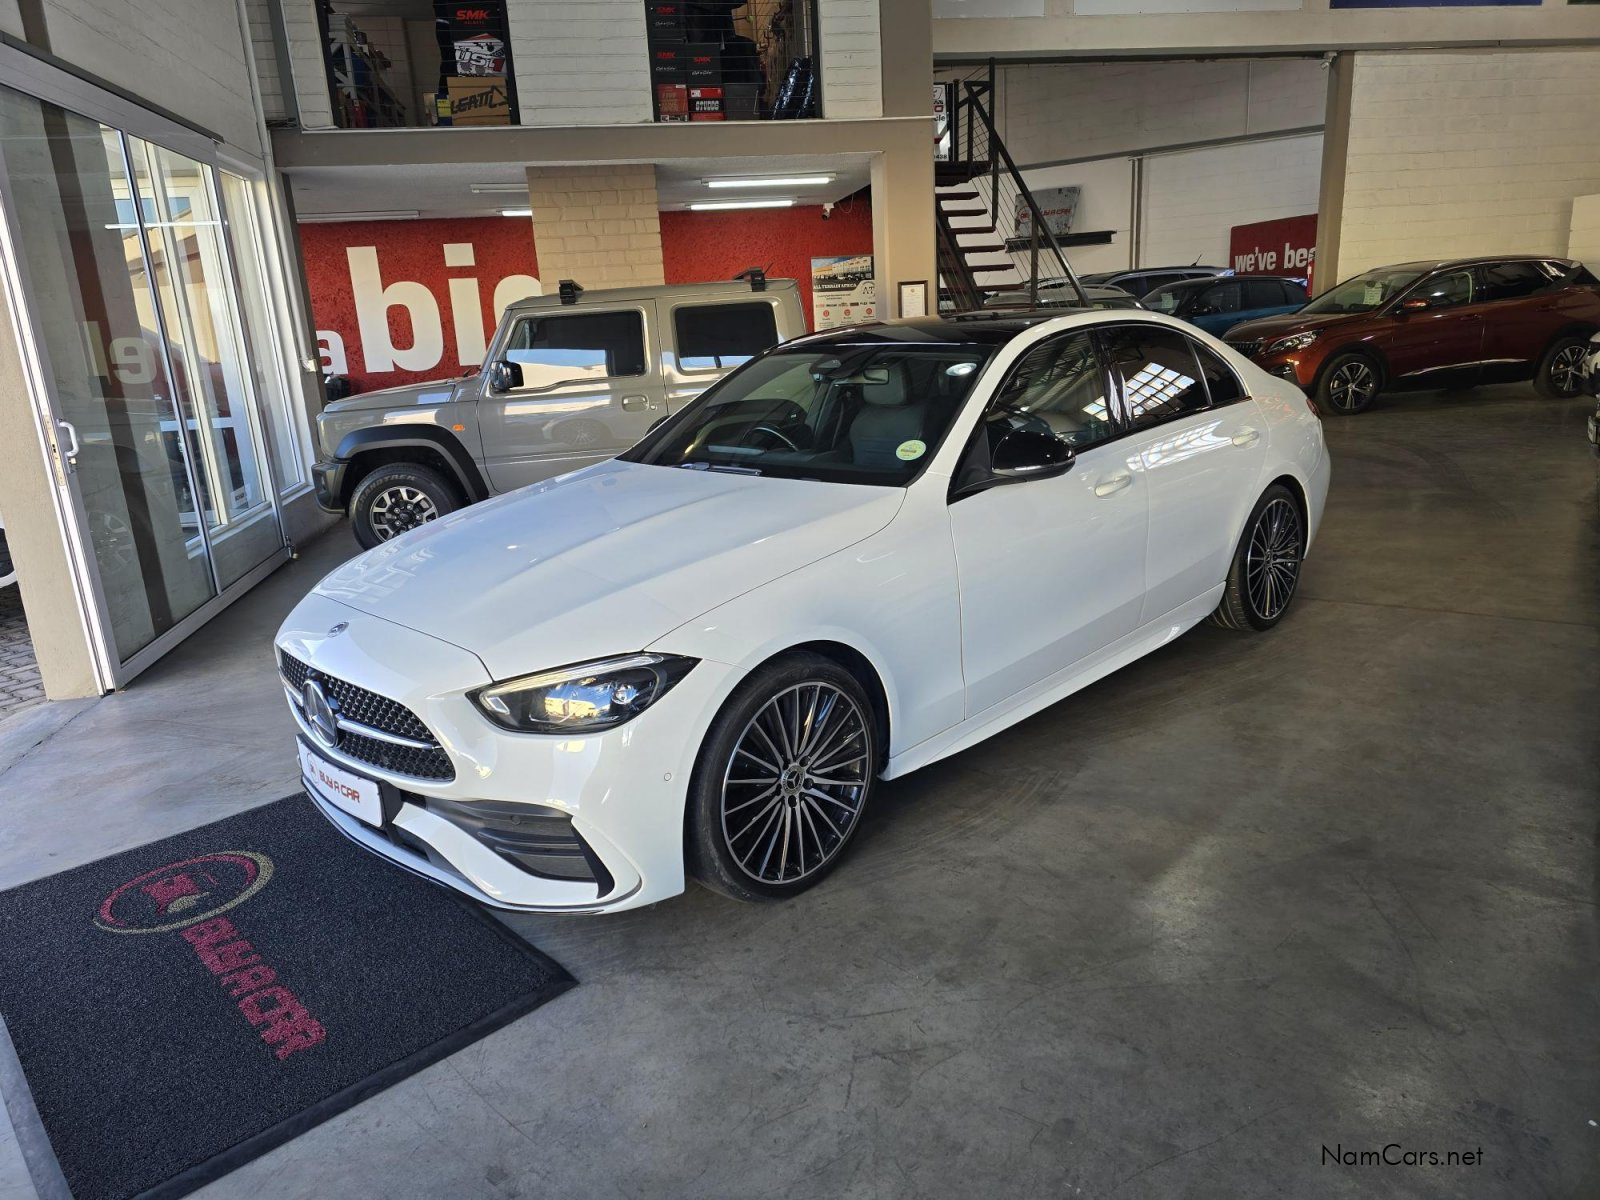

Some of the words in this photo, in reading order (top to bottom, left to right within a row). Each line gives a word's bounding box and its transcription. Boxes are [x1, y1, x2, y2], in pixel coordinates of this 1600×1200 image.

[456, 9, 490, 19] SMK
[1235, 247, 1277, 272] we've
[319, 769, 333, 790] BUY
[334, 781, 340, 794] A
[340, 784, 361, 803] CAR
[180, 917, 262, 976] BUY
[238, 985, 327, 1061] CAR
